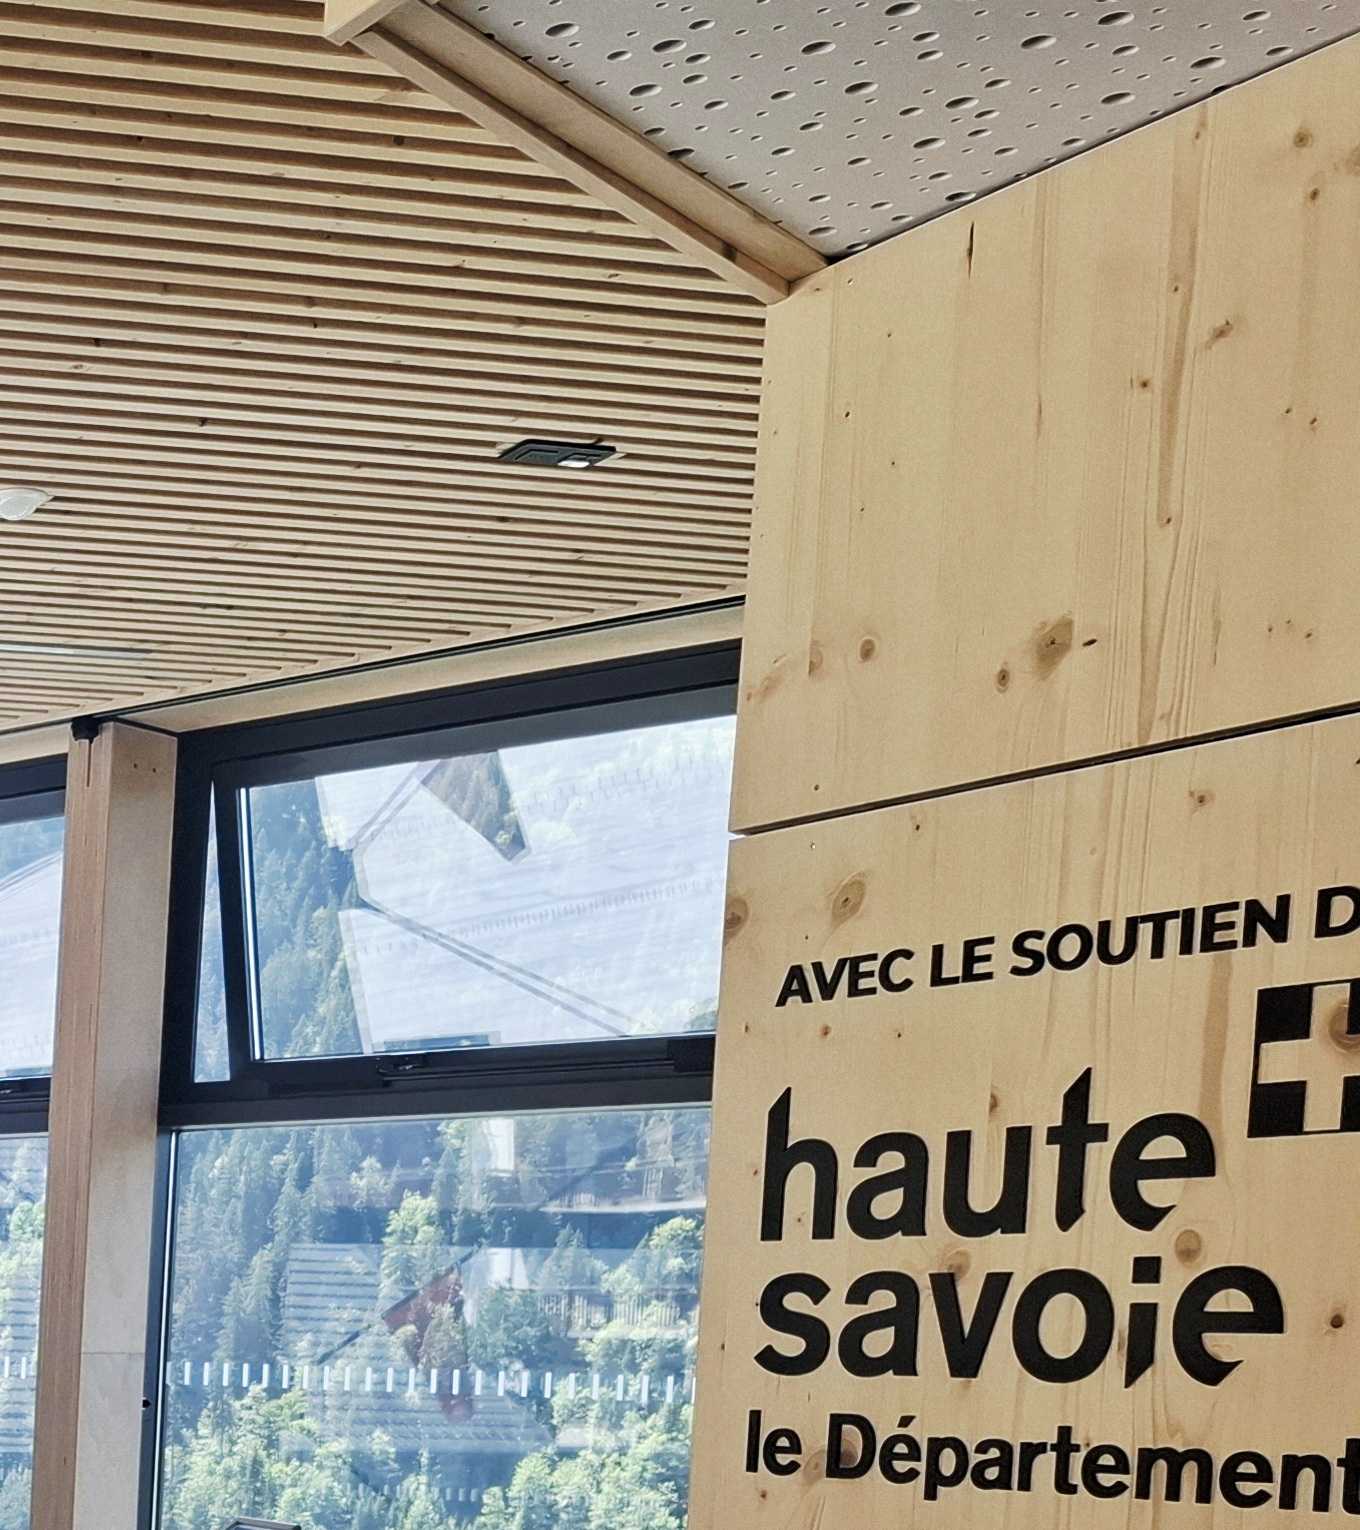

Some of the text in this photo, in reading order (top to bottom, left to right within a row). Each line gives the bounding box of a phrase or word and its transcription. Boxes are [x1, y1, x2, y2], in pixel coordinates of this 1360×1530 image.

[775, 948, 915, 1008] AVEC
[929, 935, 996, 987] LE
[1009, 893, 1292, 977] SOUTIEN
[760, 1066, 1217, 1242] haute
[753, 1255, 1285, 1389] savoie
[744, 1409, 1360, 1515] le Département
